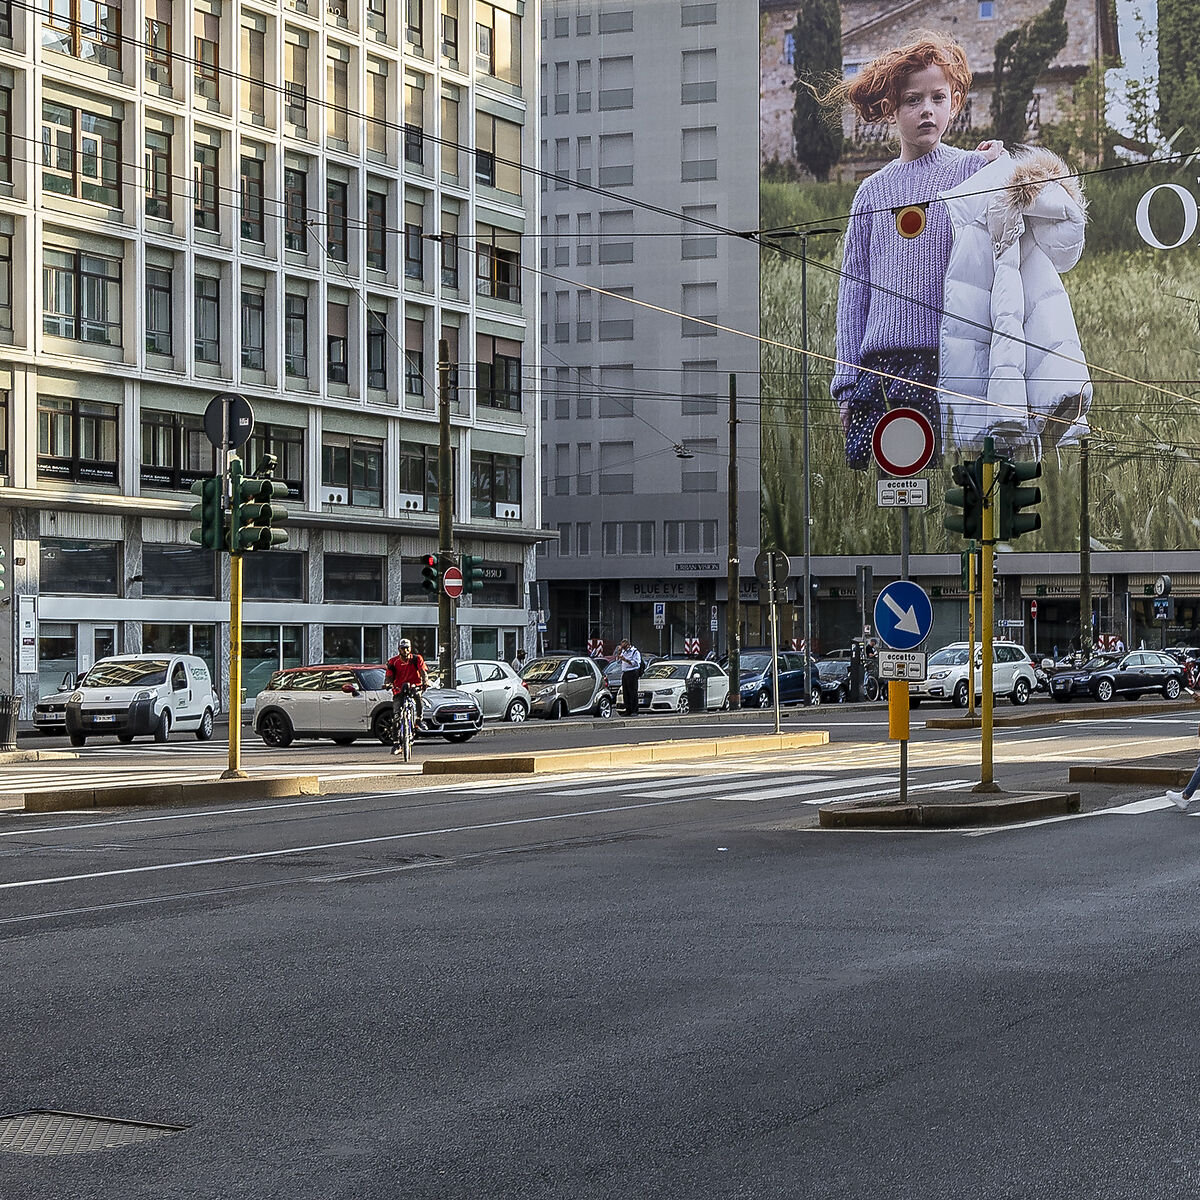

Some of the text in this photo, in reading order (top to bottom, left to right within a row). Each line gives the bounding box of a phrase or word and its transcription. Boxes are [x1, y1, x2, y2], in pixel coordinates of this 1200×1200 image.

[633, 583, 684, 594] BLUE EYE
[739, 583, 758, 593] LUE
[887, 653, 916, 661] eccetto
